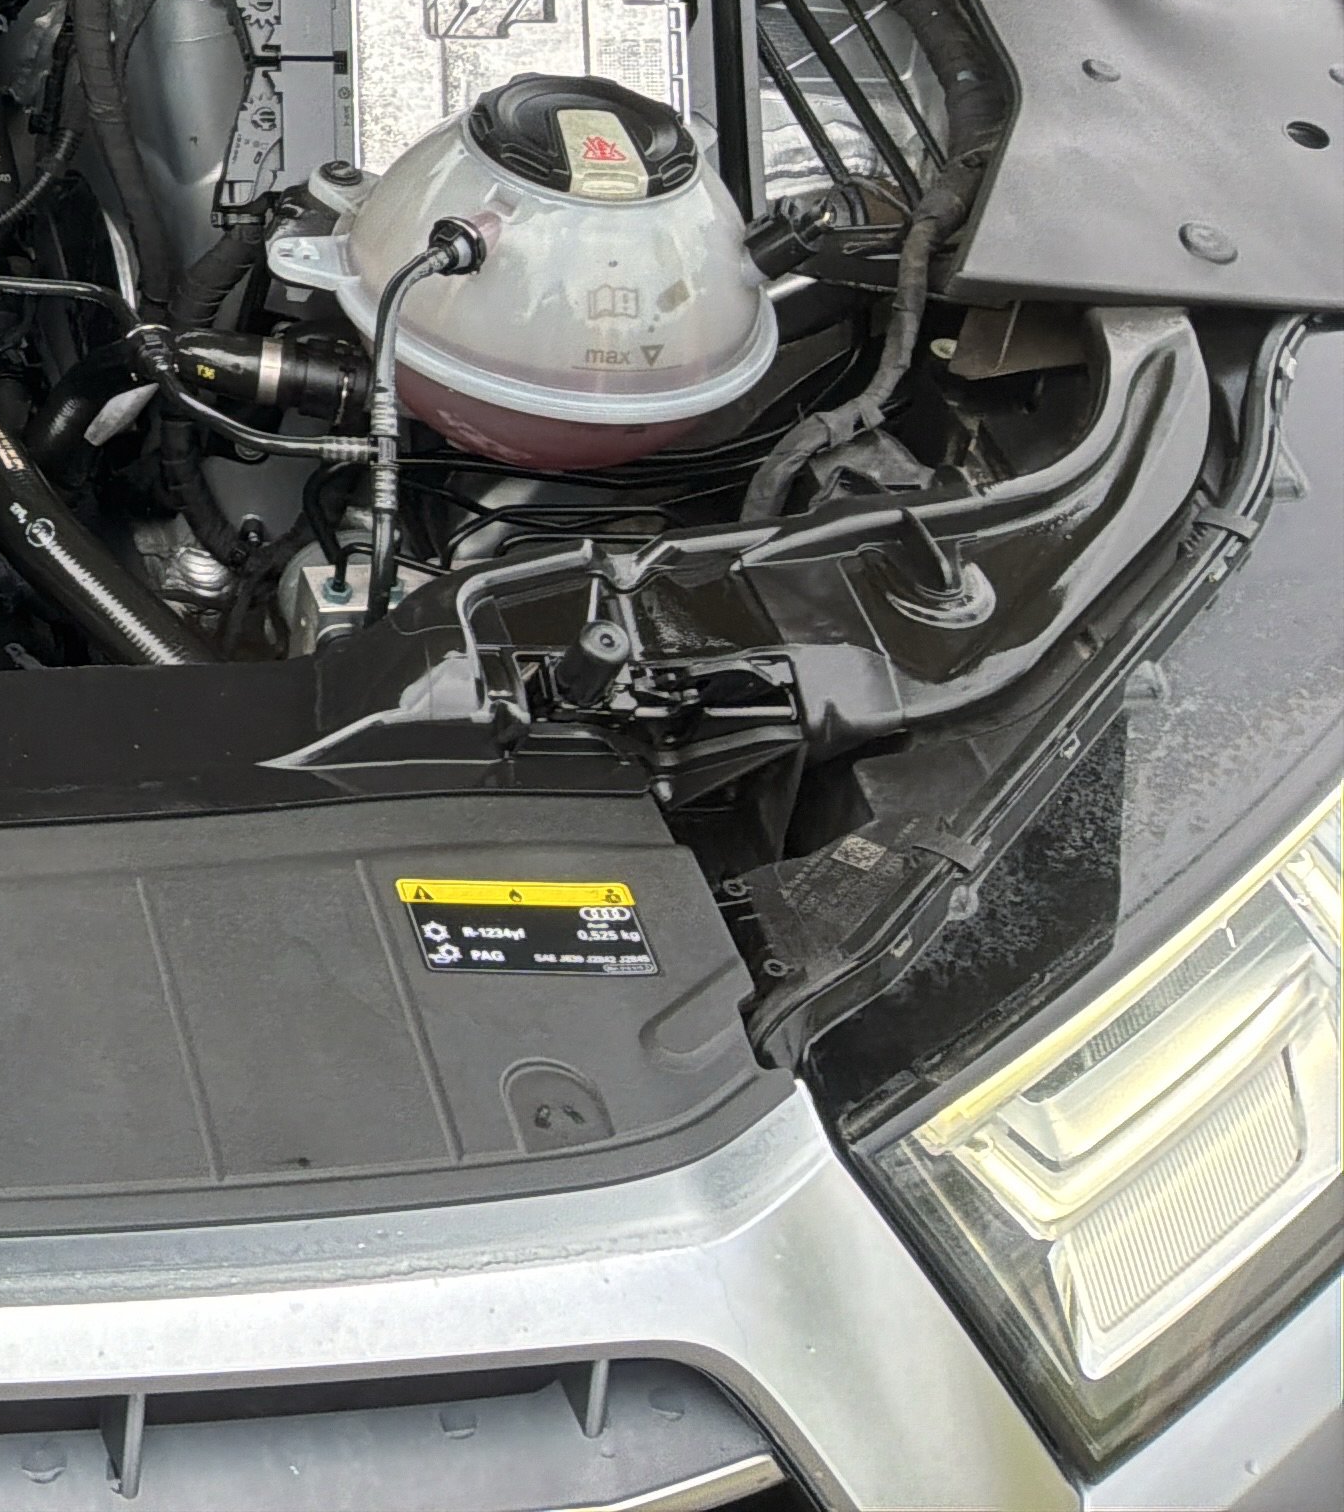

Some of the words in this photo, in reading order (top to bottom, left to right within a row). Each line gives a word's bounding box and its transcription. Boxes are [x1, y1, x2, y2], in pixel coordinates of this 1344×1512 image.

[585, 348, 631, 365] max
[462, 926, 526, 941] R-1234yf
[620, 929, 640, 942] kg
[470, 949, 506, 961] PAG
[534, 953, 558, 963] SAE
